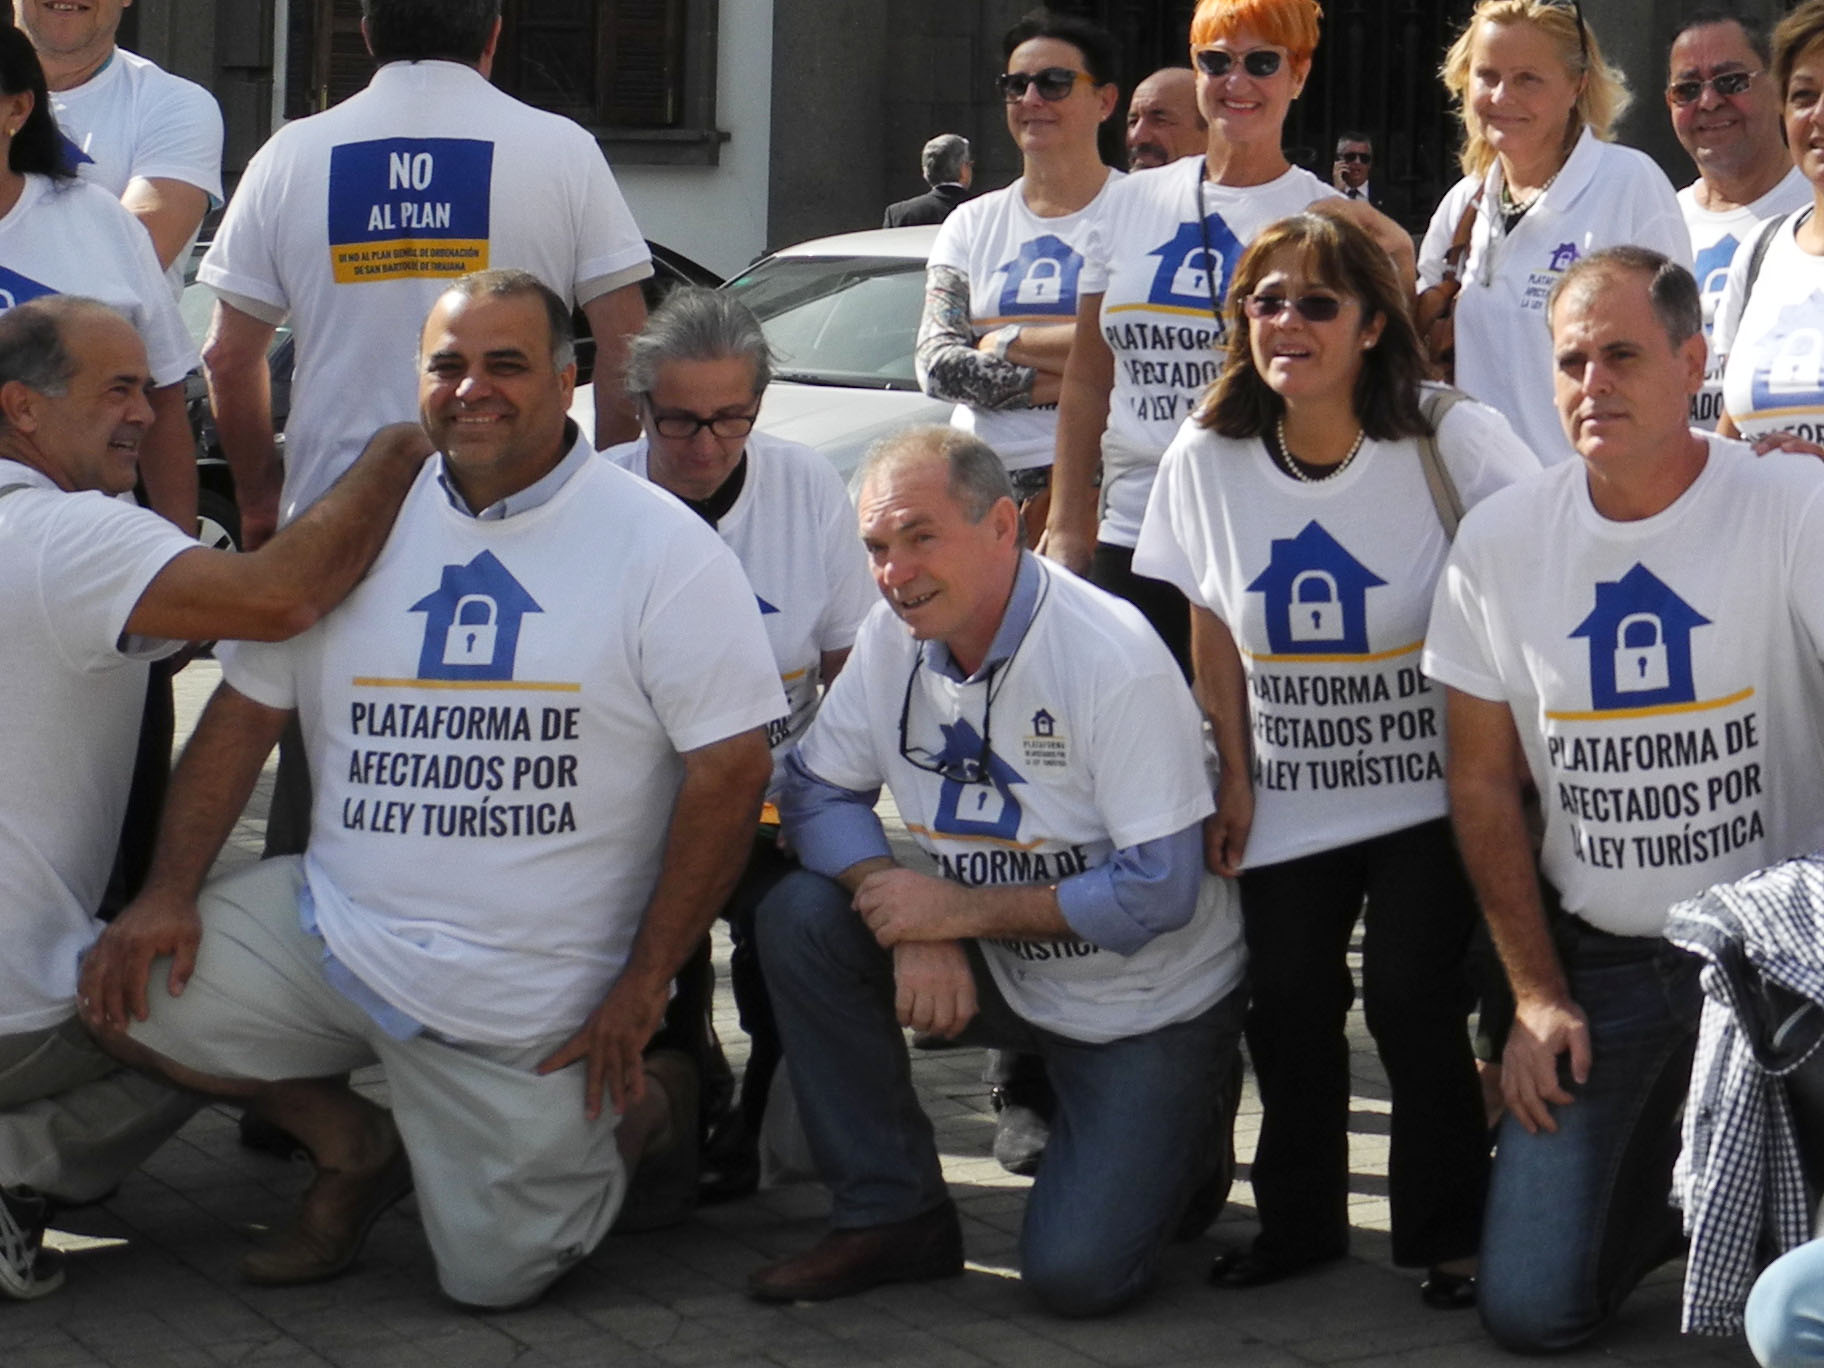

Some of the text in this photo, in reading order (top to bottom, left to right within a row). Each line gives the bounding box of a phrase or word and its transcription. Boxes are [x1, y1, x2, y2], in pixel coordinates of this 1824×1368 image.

[389, 152, 434, 191] NO
[367, 201, 450, 232] AL PLAN
[1397, 664, 1432, 698] DE
[352, 701, 581, 742] PLATAFORMA DE
[1380, 707, 1438, 743] POR
[1548, 712, 1759, 773] PLATAFORMA DE
[350, 749, 578, 791] AFECTADOS POR
[1266, 759, 1300, 792] LEY
[1305, 749, 1444, 791] TURÍSTICA
[1559, 762, 1762, 823] AFECTADOS POR
[343, 796, 577, 837] LA LEY TURÍSTICA
[1588, 835, 1626, 870] LEY
[1632, 810, 1765, 869] TURÍSTICA
